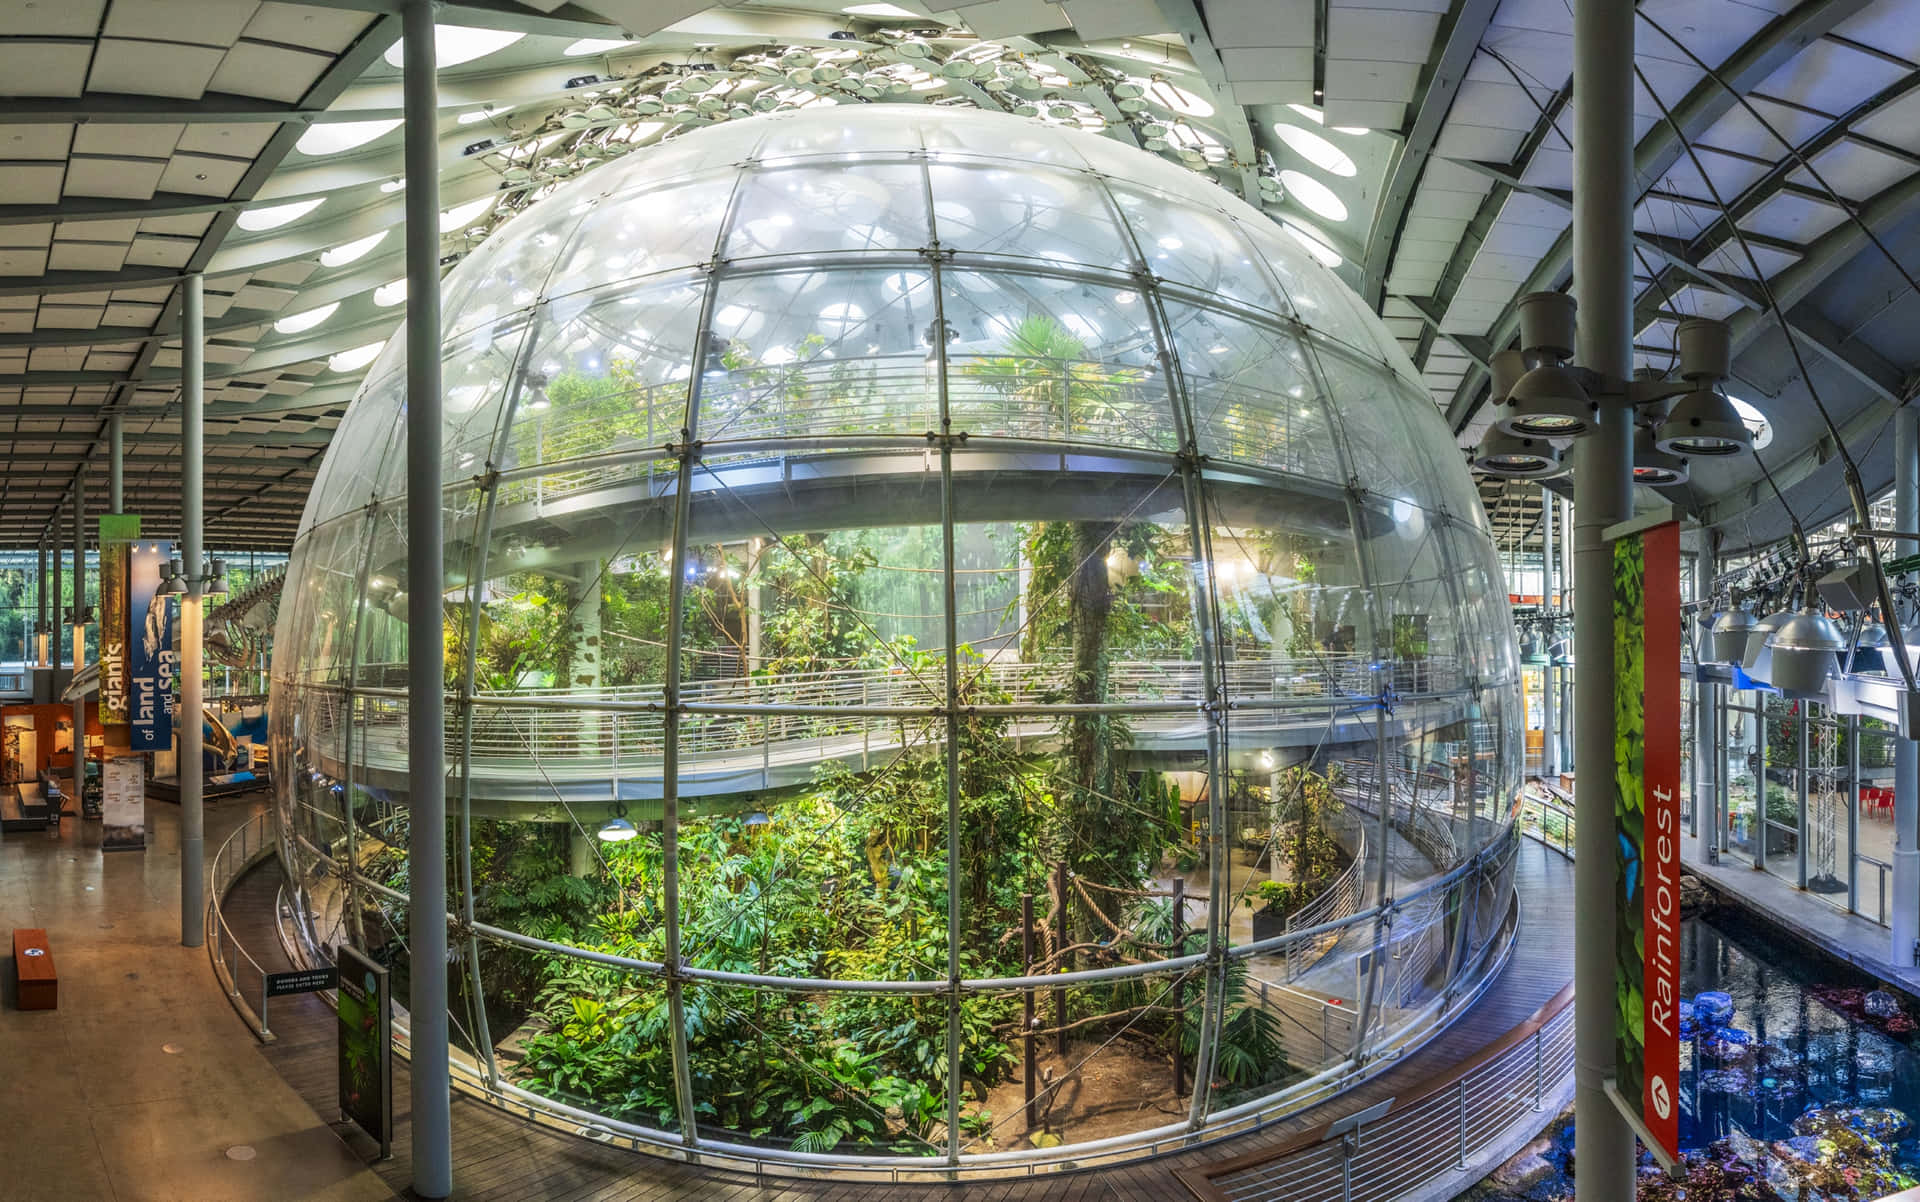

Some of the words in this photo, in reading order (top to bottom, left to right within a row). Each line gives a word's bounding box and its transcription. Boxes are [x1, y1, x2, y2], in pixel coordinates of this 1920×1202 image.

[103, 643, 127, 711] giants
[158, 650, 173, 690] sea
[132, 677, 154, 725] land
[160, 694, 173, 714] and
[142, 729, 154, 741] of
[1652, 784, 1672, 1037] Rainforest
